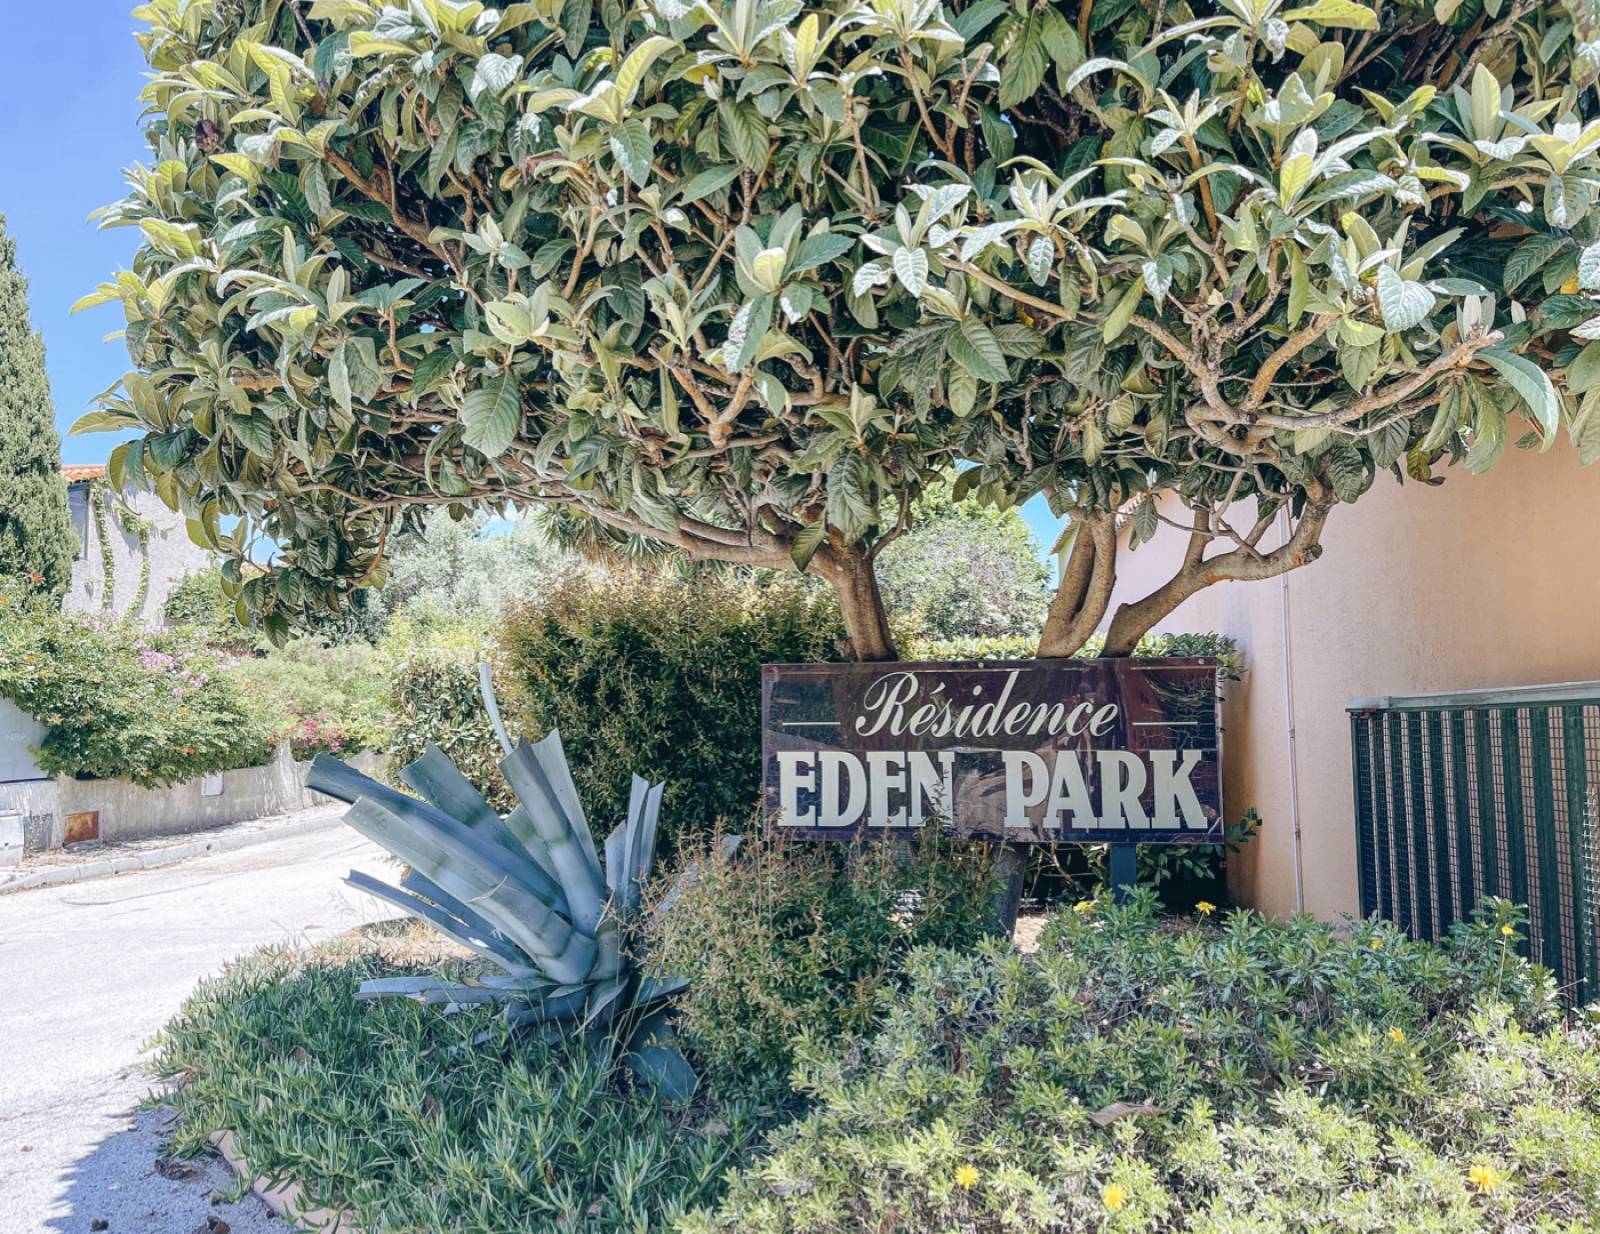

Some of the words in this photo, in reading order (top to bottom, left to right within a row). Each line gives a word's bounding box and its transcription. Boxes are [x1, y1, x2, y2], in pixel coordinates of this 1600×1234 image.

[855, 671, 1119, 737] Résidence
[777, 751, 955, 827] EDEN
[1002, 750, 1208, 829] PARK
